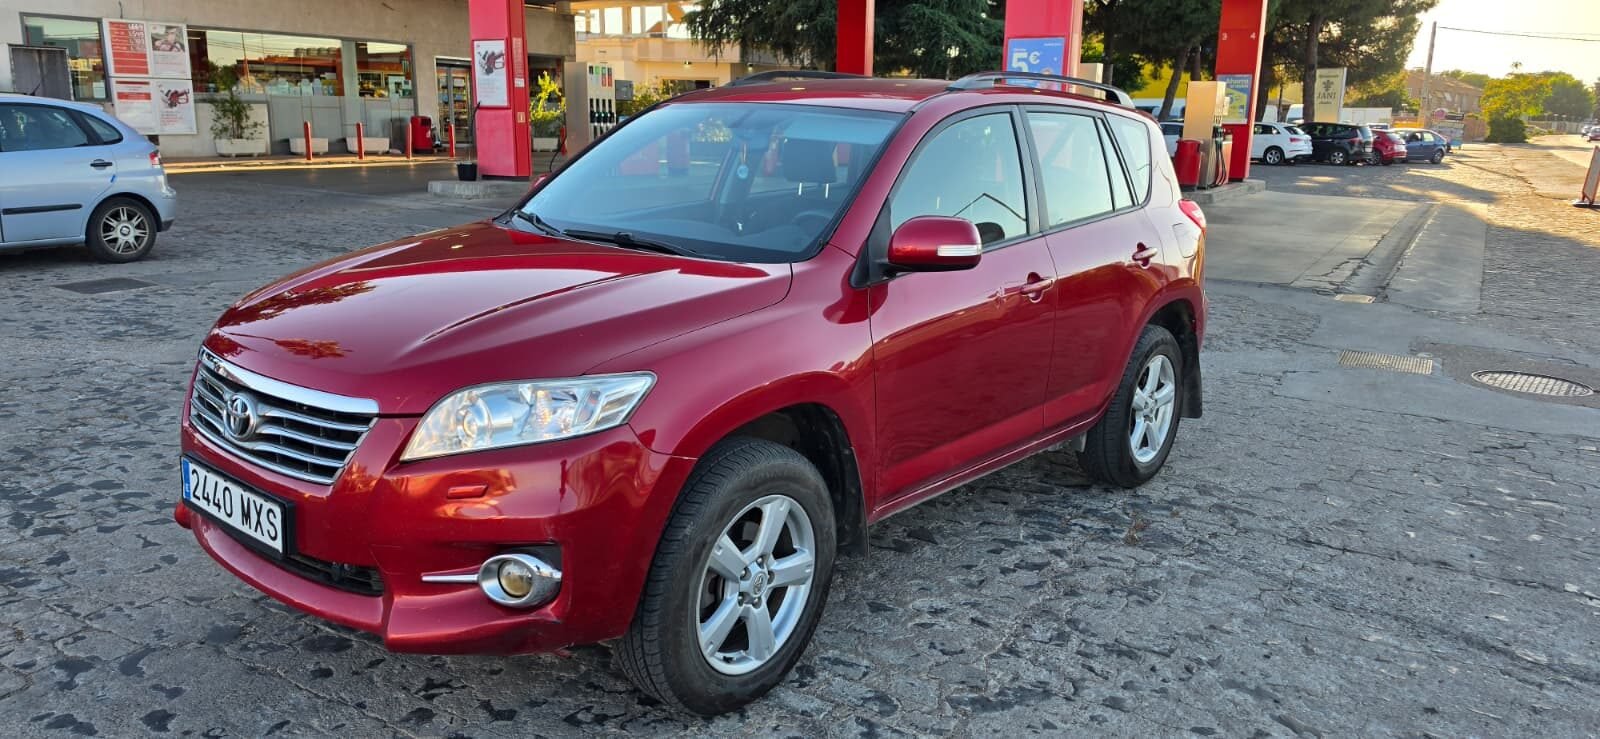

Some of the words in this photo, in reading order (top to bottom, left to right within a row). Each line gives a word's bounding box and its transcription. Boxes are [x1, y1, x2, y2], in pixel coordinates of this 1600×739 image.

[1222, 32, 1228, 41] 3
[1250, 32, 1256, 40] 4
[191, 468, 233, 518] 2440
[240, 494, 278, 541] MXS
